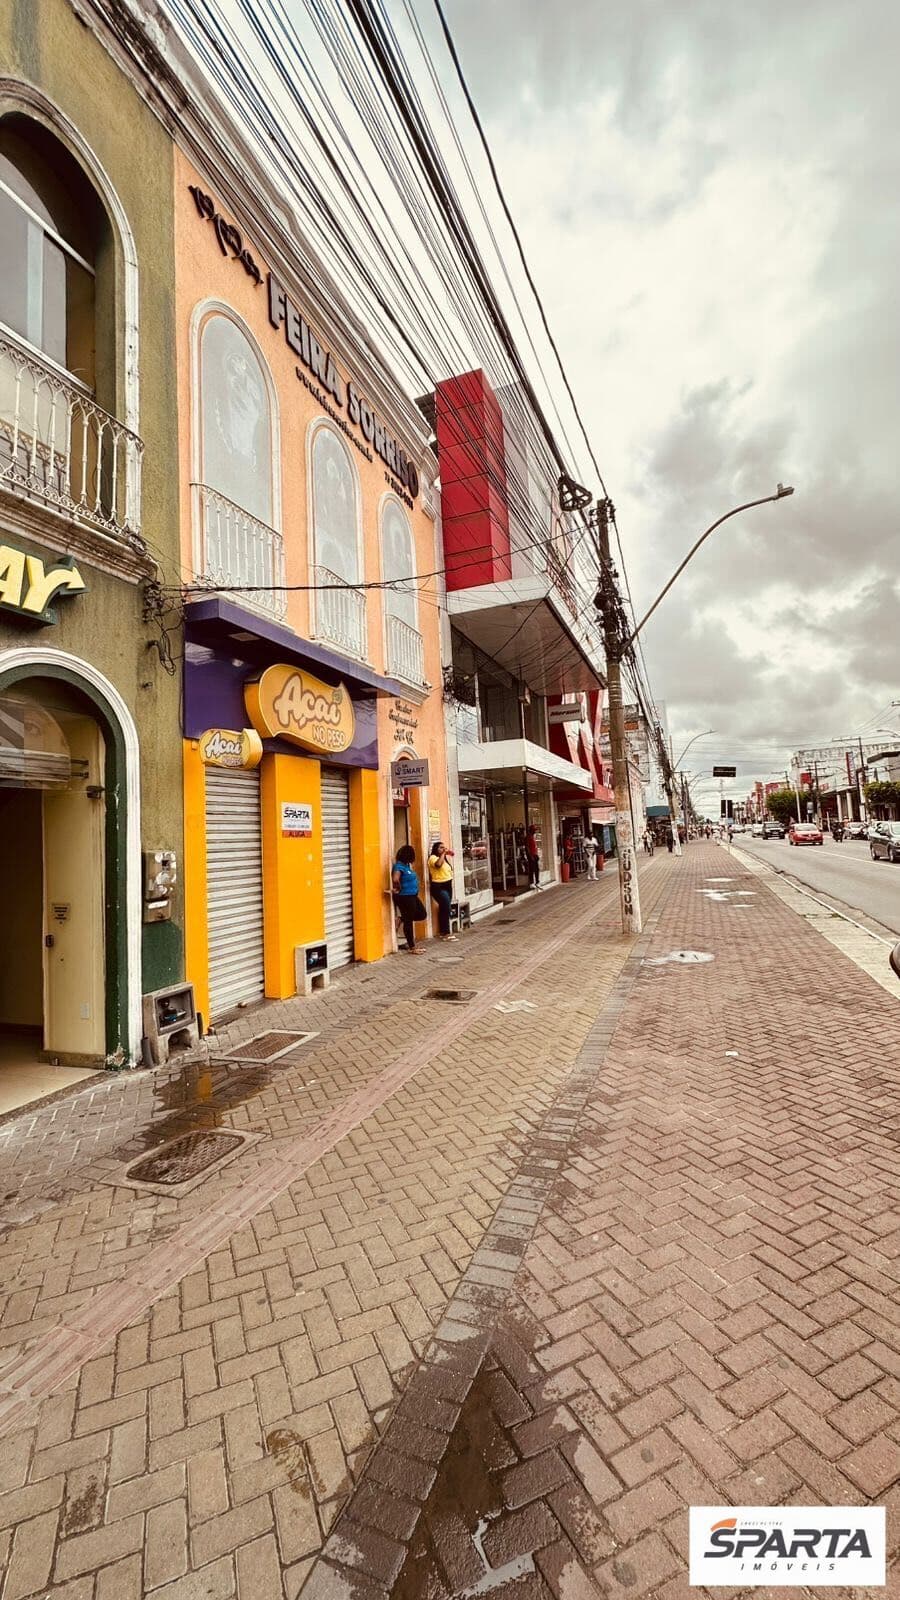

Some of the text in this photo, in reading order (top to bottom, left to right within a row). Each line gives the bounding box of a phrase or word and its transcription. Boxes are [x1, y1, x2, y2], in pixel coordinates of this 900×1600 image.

[267, 271, 343, 407] FEIRA
[347, 381, 419, 498] SORRISO
[312, 724, 345, 748] NO PESO
[284, 808, 310, 819] SPARTA
